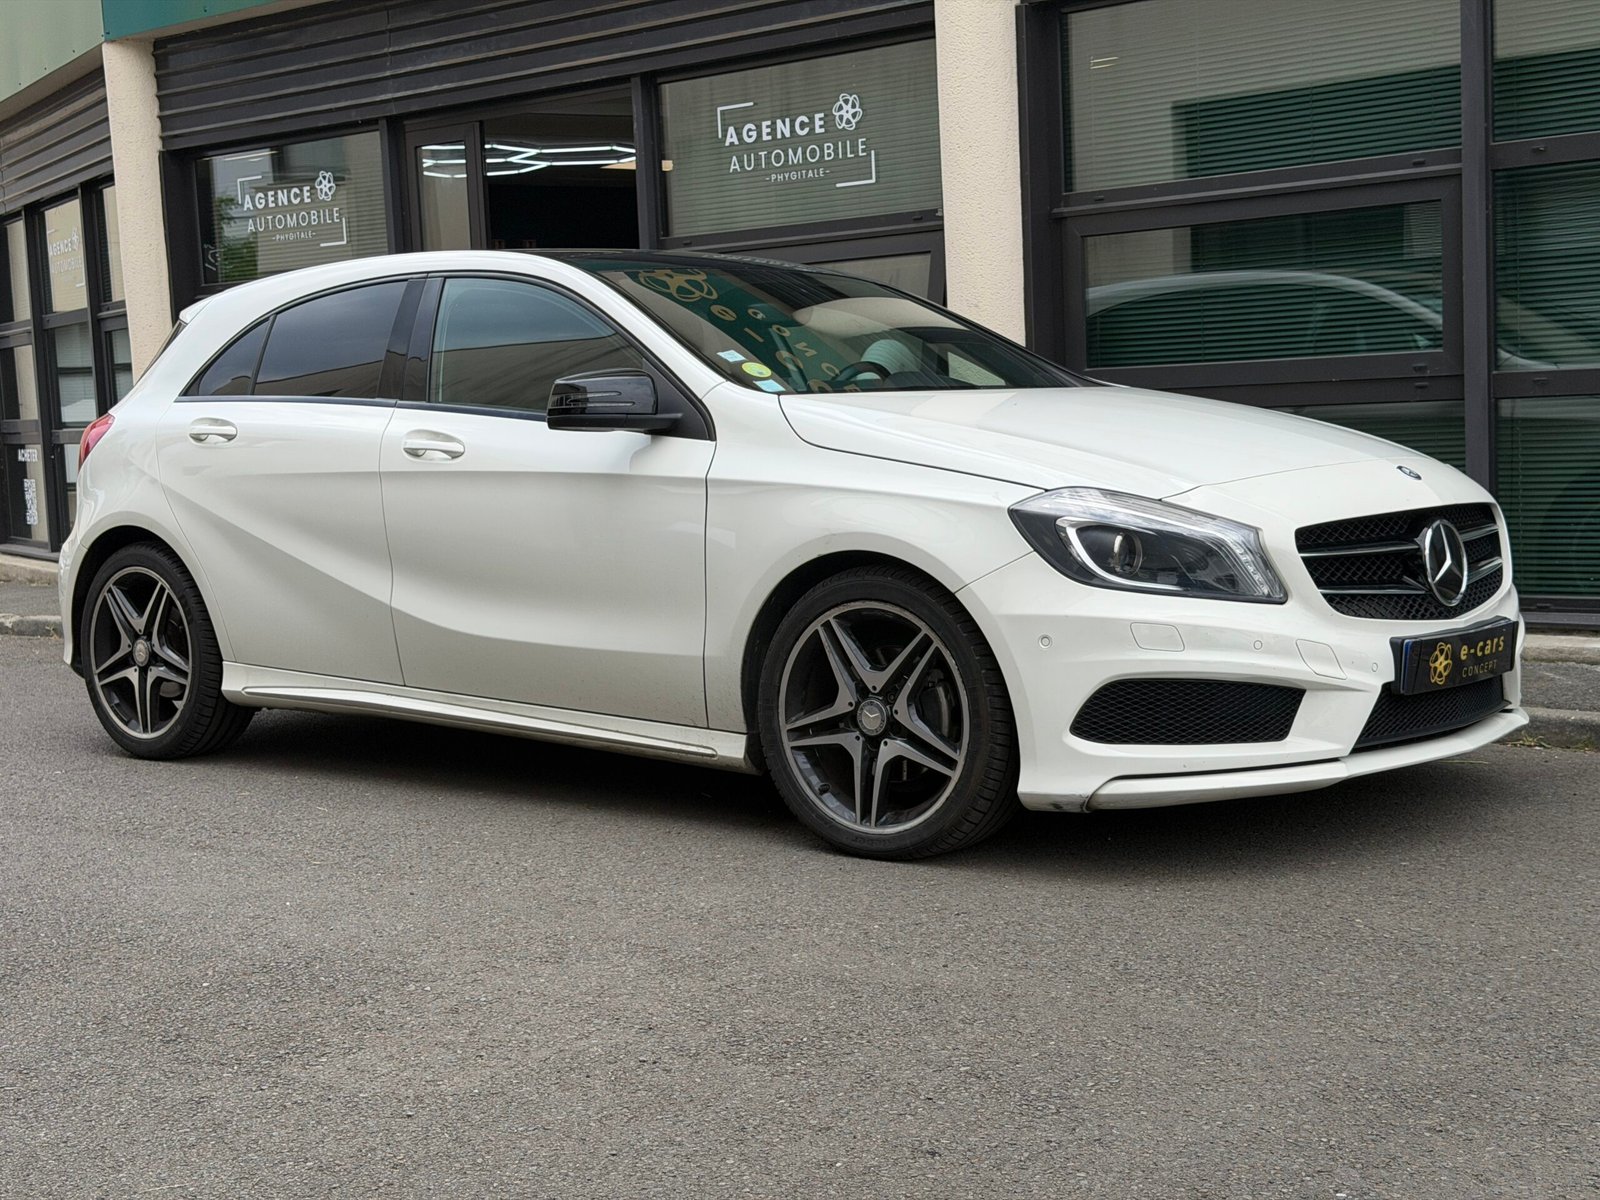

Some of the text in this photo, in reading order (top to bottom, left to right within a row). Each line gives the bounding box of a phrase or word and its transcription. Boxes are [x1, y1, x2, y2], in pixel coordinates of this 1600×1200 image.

[725, 112, 825, 146] AGENCE
[729, 138, 867, 173] AUTOMOBILE
[243, 186, 312, 211] AGENCE
[247, 207, 341, 233] AUTOMOBILE
[48, 238, 72, 256] AGENCE
[1460, 636, 1504, 660] e-cars
[1462, 660, 1497, 678] CONCEPT
